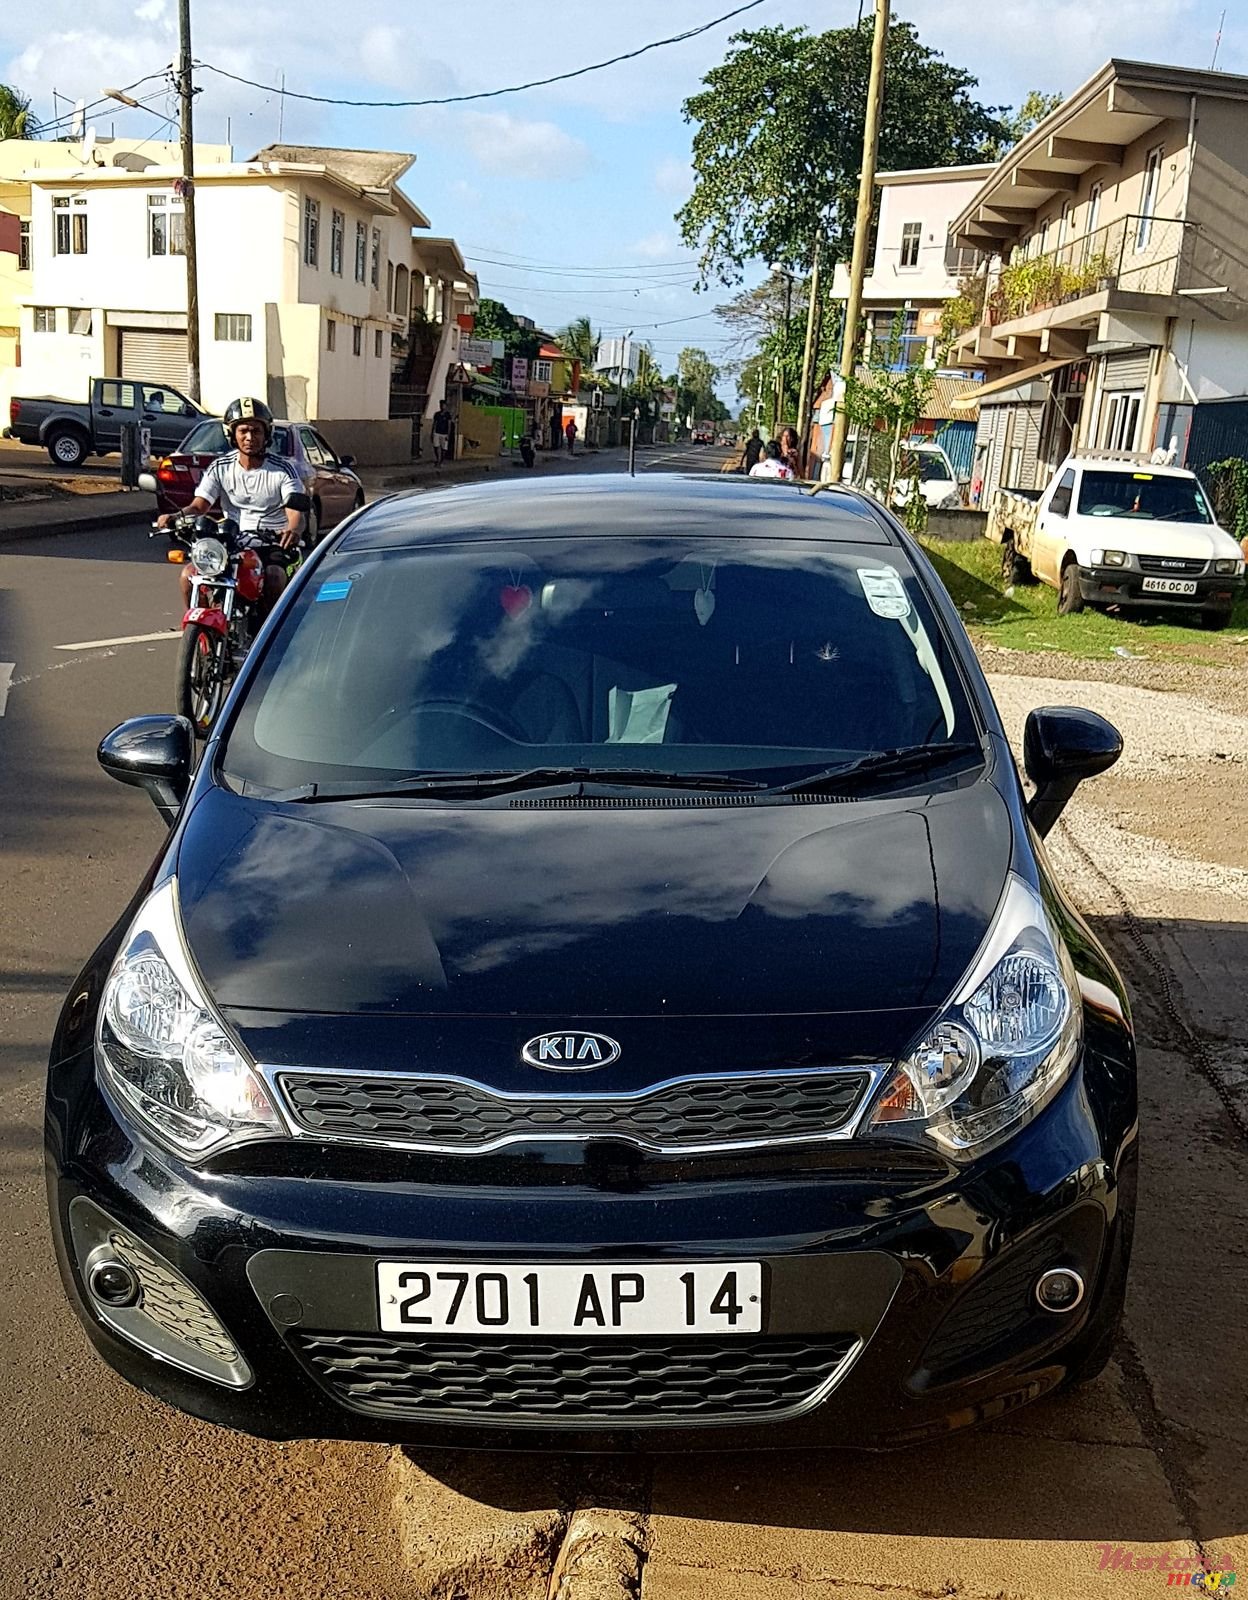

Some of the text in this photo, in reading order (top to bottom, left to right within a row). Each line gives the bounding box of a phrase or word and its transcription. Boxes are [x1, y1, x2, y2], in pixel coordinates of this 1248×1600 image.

[1145, 580, 1195, 592] 4616 OC 00
[539, 1037, 602, 1060] KIA
[398, 1271, 743, 1327] 2701 AP 14
